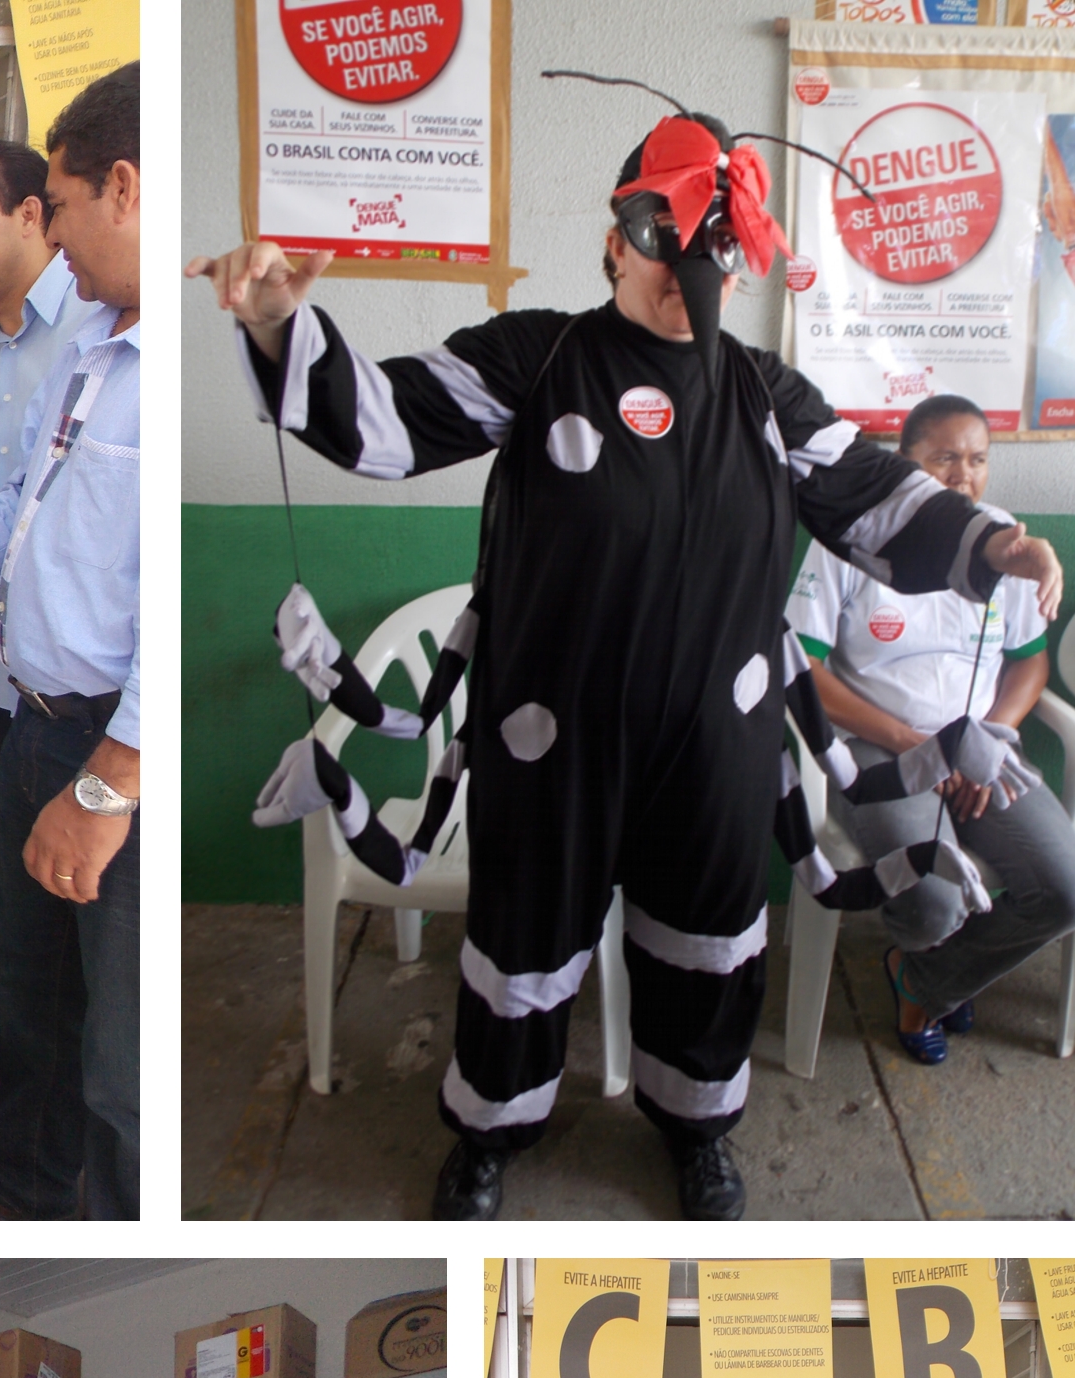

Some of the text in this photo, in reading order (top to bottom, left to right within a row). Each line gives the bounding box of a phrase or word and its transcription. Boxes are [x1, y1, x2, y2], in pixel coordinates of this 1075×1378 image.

[301, 3, 444, 43] SE VOCÊ AGIR,
[32, 27, 93, 49] LAVE AS MÃOS APÓS
[325, 31, 428, 66] PODEMOS
[343, 60, 420, 90] EVITAR.
[271, 109, 313, 119] CUIDE DA
[341, 112, 386, 122] FALE COM
[412, 115, 483, 127] CONVERSE COM
[269, 119, 315, 130] SUA CASA.
[329, 122, 397, 133] SEUS VIZINHOS.
[266, 143, 483, 167] O BRASIL CONTA COM VOCÊ.
[849, 138, 977, 190] DENGUE
[356, 201, 397, 213] DENGUE
[851, 190, 985, 230] SE VOCÊ AGIR,
[357, 211, 399, 227] MATA
[872, 216, 969, 250] PODEMOS
[887, 242, 958, 272] EVITAR.
[811, 323, 1011, 339] O CONTA COM VOCÊ.
[564, 1271, 642, 1290] EVITE A HEPATITE
[711, 1271, 740, 1279] VACINE-SE
[892, 1263, 968, 1284] EVITE A HEPATITE
[724, 1293, 756, 1301] CAMISINHA
[756, 1292, 779, 1300] SEMPRE
